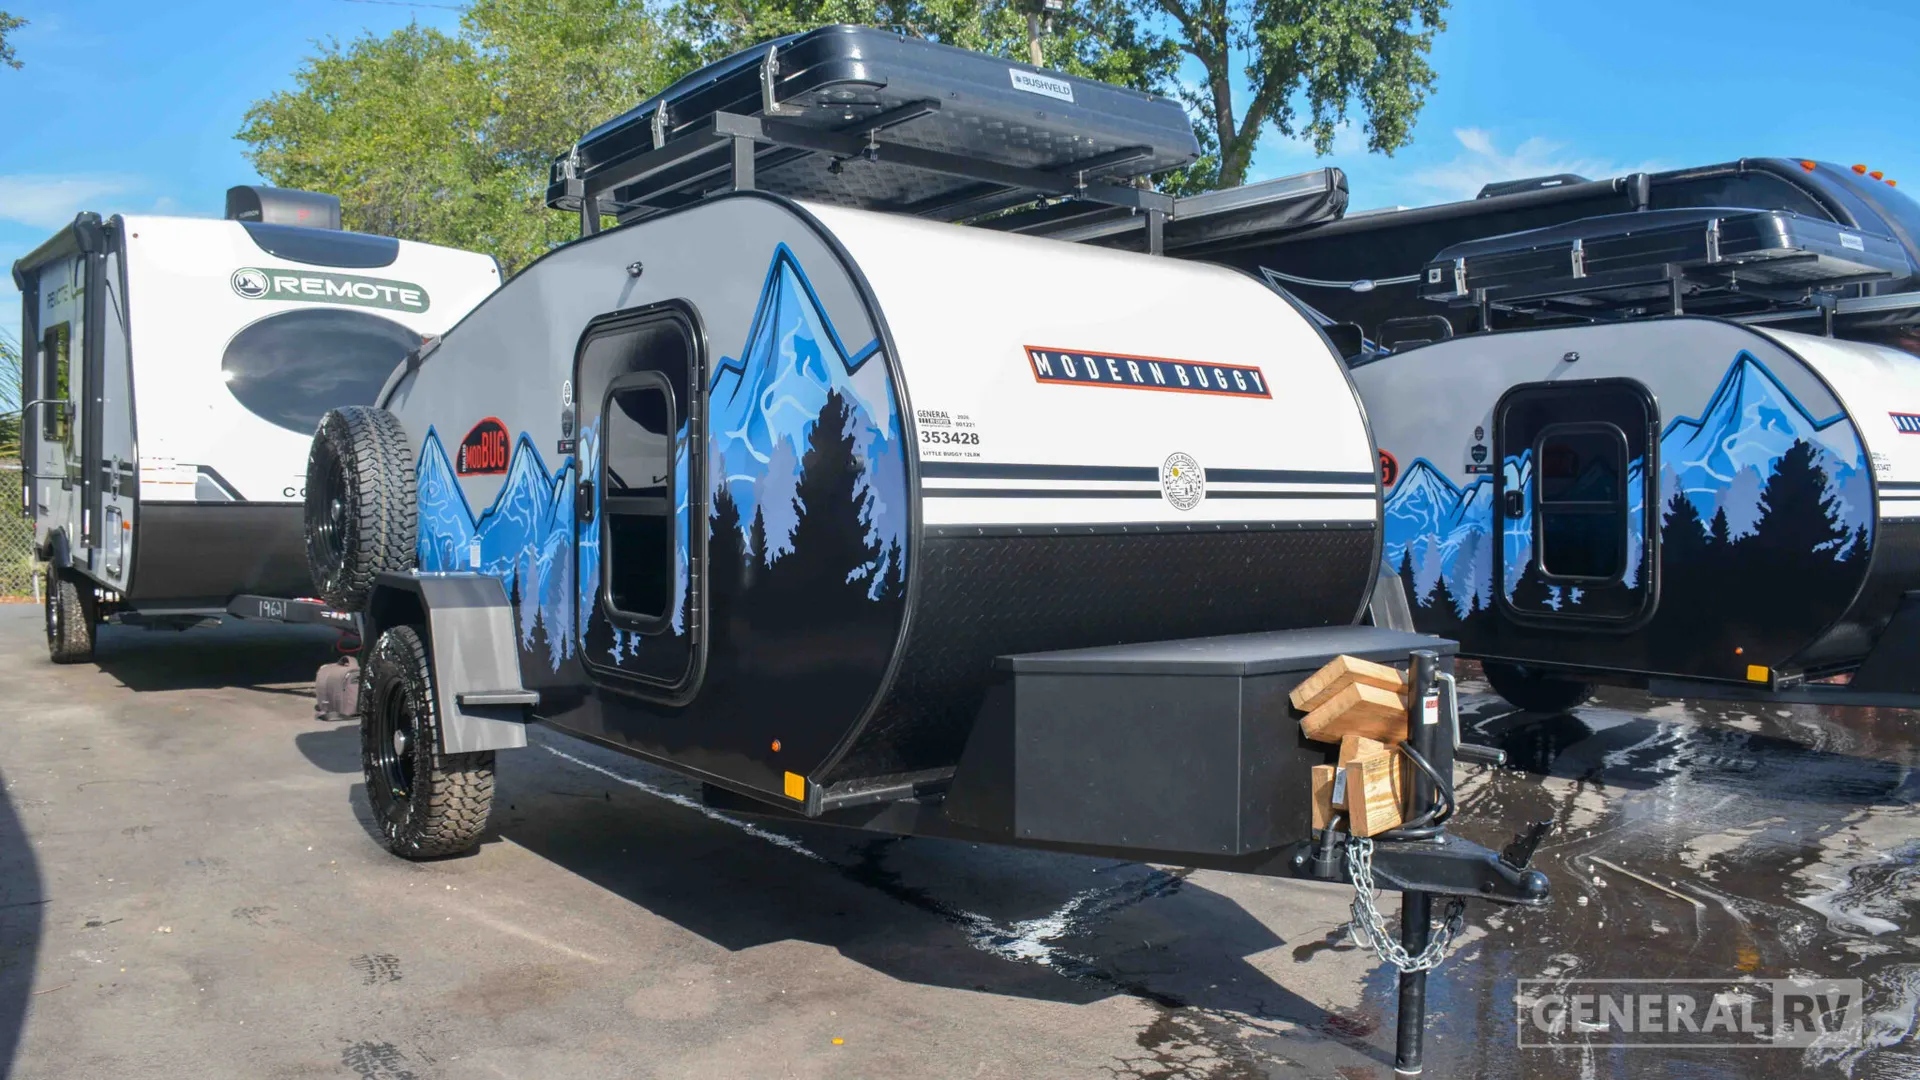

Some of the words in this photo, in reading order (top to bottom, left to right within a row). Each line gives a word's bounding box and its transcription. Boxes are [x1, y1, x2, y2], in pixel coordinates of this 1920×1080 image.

[1022, 76, 1071, 95] BUSHVELD
[273, 275, 422, 307] REMOTE
[1031, 351, 1166, 385] MODERN
[1174, 364, 1264, 393] BUGGY
[917, 409, 950, 418] GENERAL
[920, 430, 980, 445] 353428
